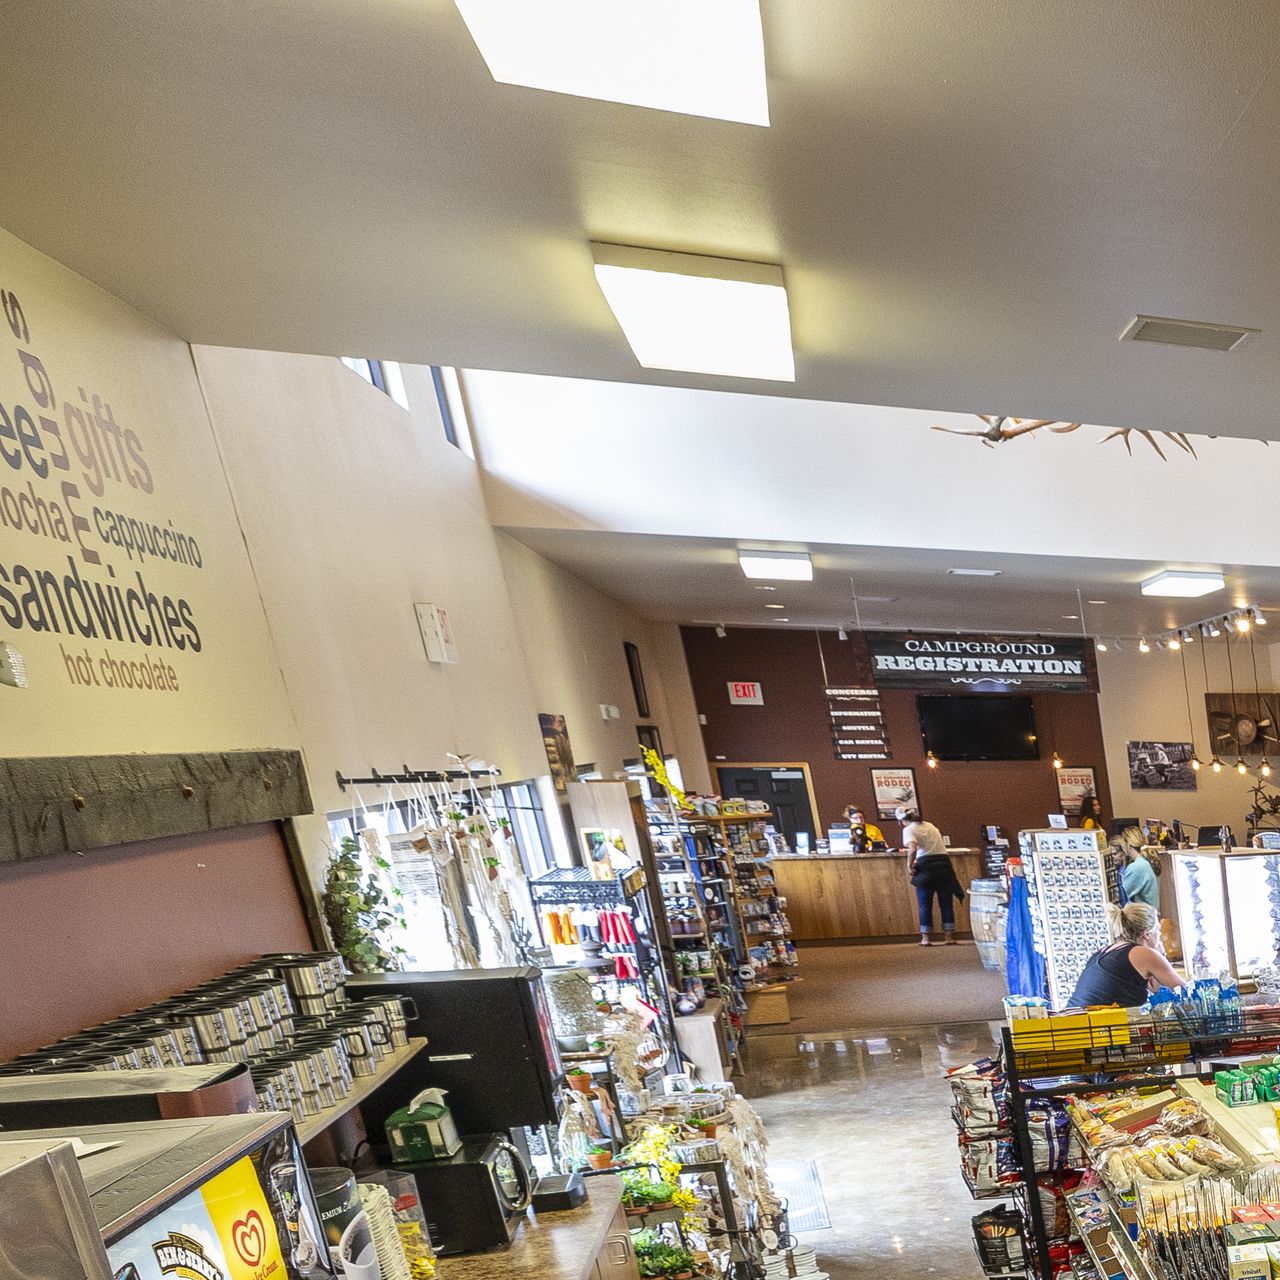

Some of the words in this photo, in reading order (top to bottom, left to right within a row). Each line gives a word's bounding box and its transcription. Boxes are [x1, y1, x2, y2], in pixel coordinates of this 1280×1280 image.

[63, 386, 153, 497] gifts
[93, 506, 202, 568] cappuccino
[0, 555, 202, 652] sandwiches
[905, 640, 1055, 656] CAMPGROUND
[59, 643, 101, 686] hot
[100, 649, 179, 692] chocolate
[875, 655, 1082, 675] REGISTRATION
[733, 682, 758, 700] EXIT
[825, 688, 879, 696] CONCIERGE
[877, 779, 912, 788] RODEO
[1060, 777, 1092, 786] RODEO
